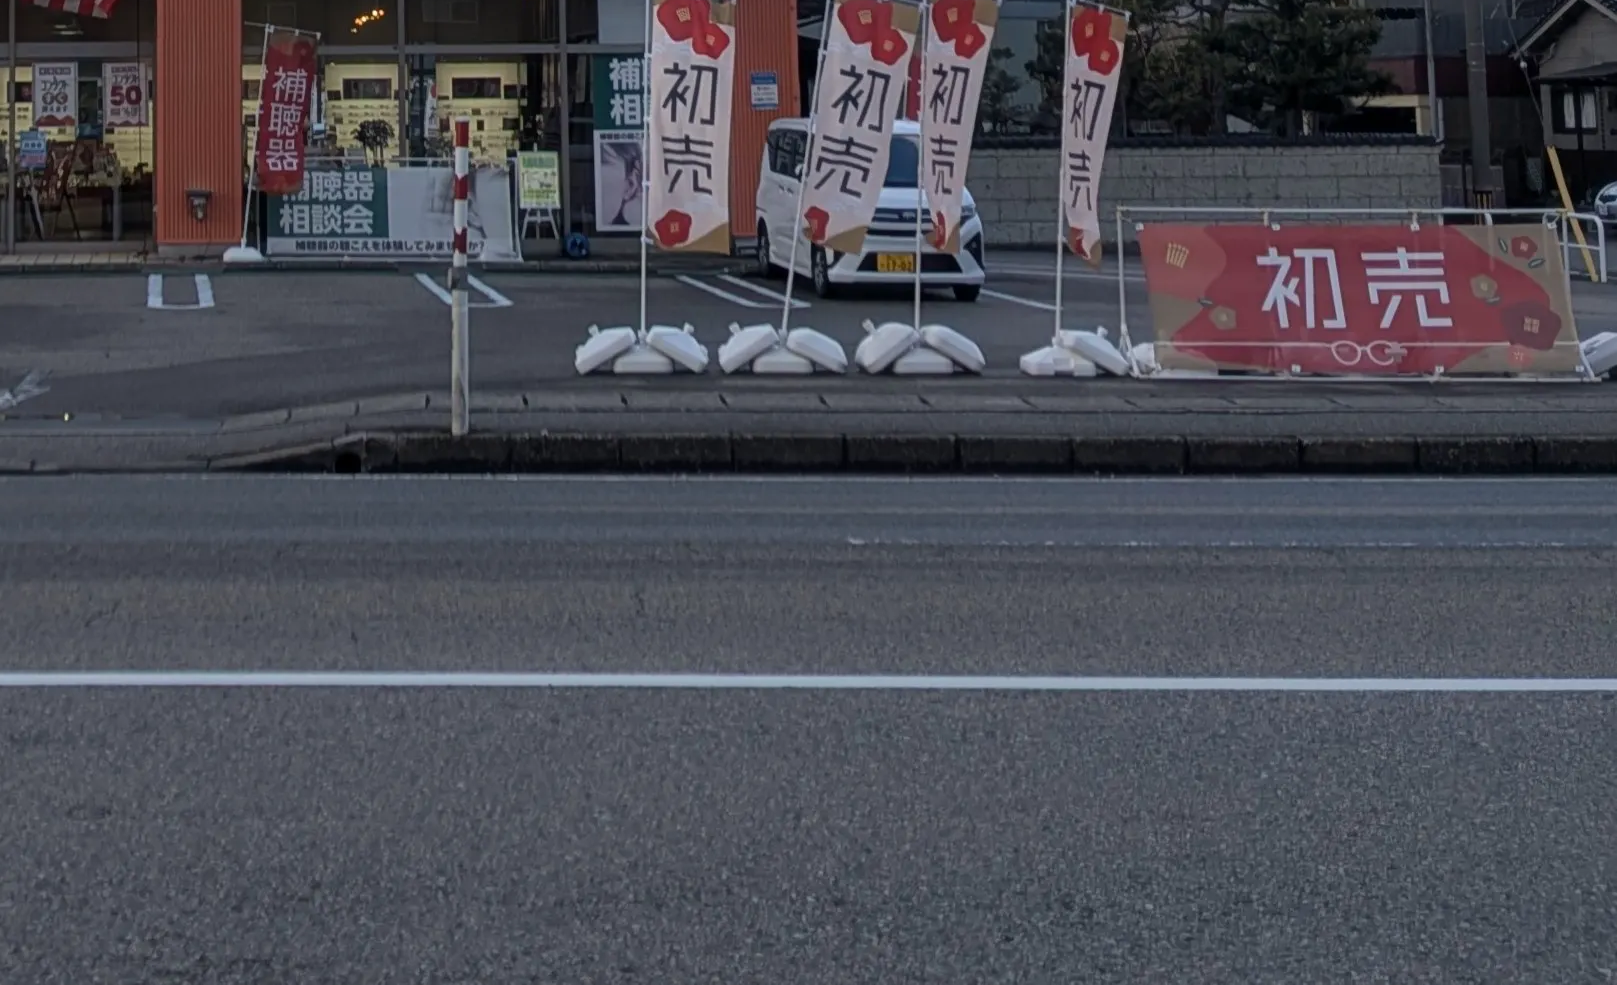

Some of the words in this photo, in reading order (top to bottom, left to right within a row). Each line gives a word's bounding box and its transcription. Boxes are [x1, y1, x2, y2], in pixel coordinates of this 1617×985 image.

[110, 85, 142, 106] 50
[265, 67, 309, 172] 補聴器
[661, 61, 719, 196] 初売
[814, 63, 891, 199] 初売
[929, 63, 971, 196] 初売
[1068, 77, 1106, 212] 初売
[279, 204, 374, 236] 相談会
[1255, 246, 1454, 329] 初売
